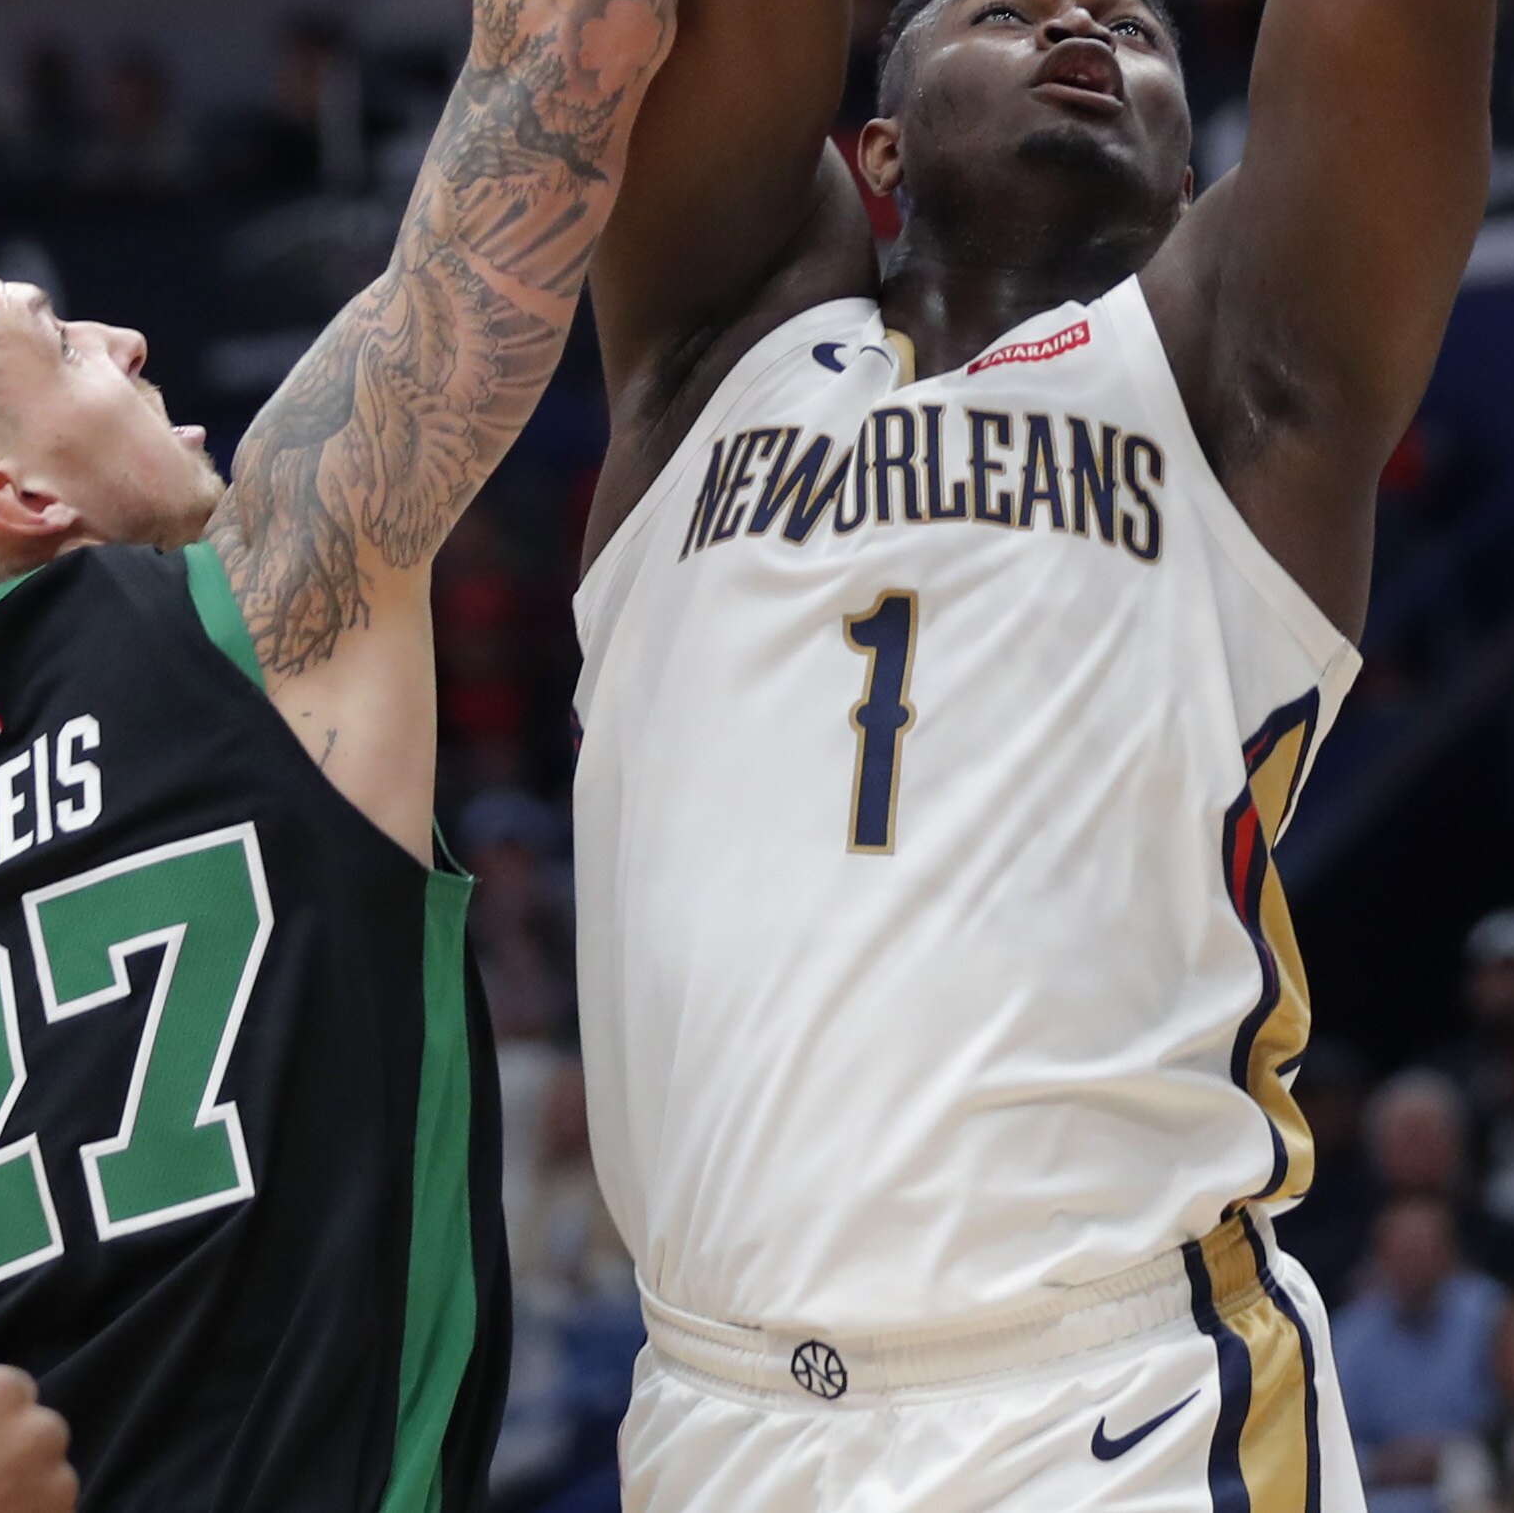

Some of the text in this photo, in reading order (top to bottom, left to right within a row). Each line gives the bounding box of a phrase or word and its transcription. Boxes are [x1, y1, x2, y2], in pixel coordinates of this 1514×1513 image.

[677, 403, 1165, 566] NEW ORLEANS
[842, 587, 919, 856] 1
